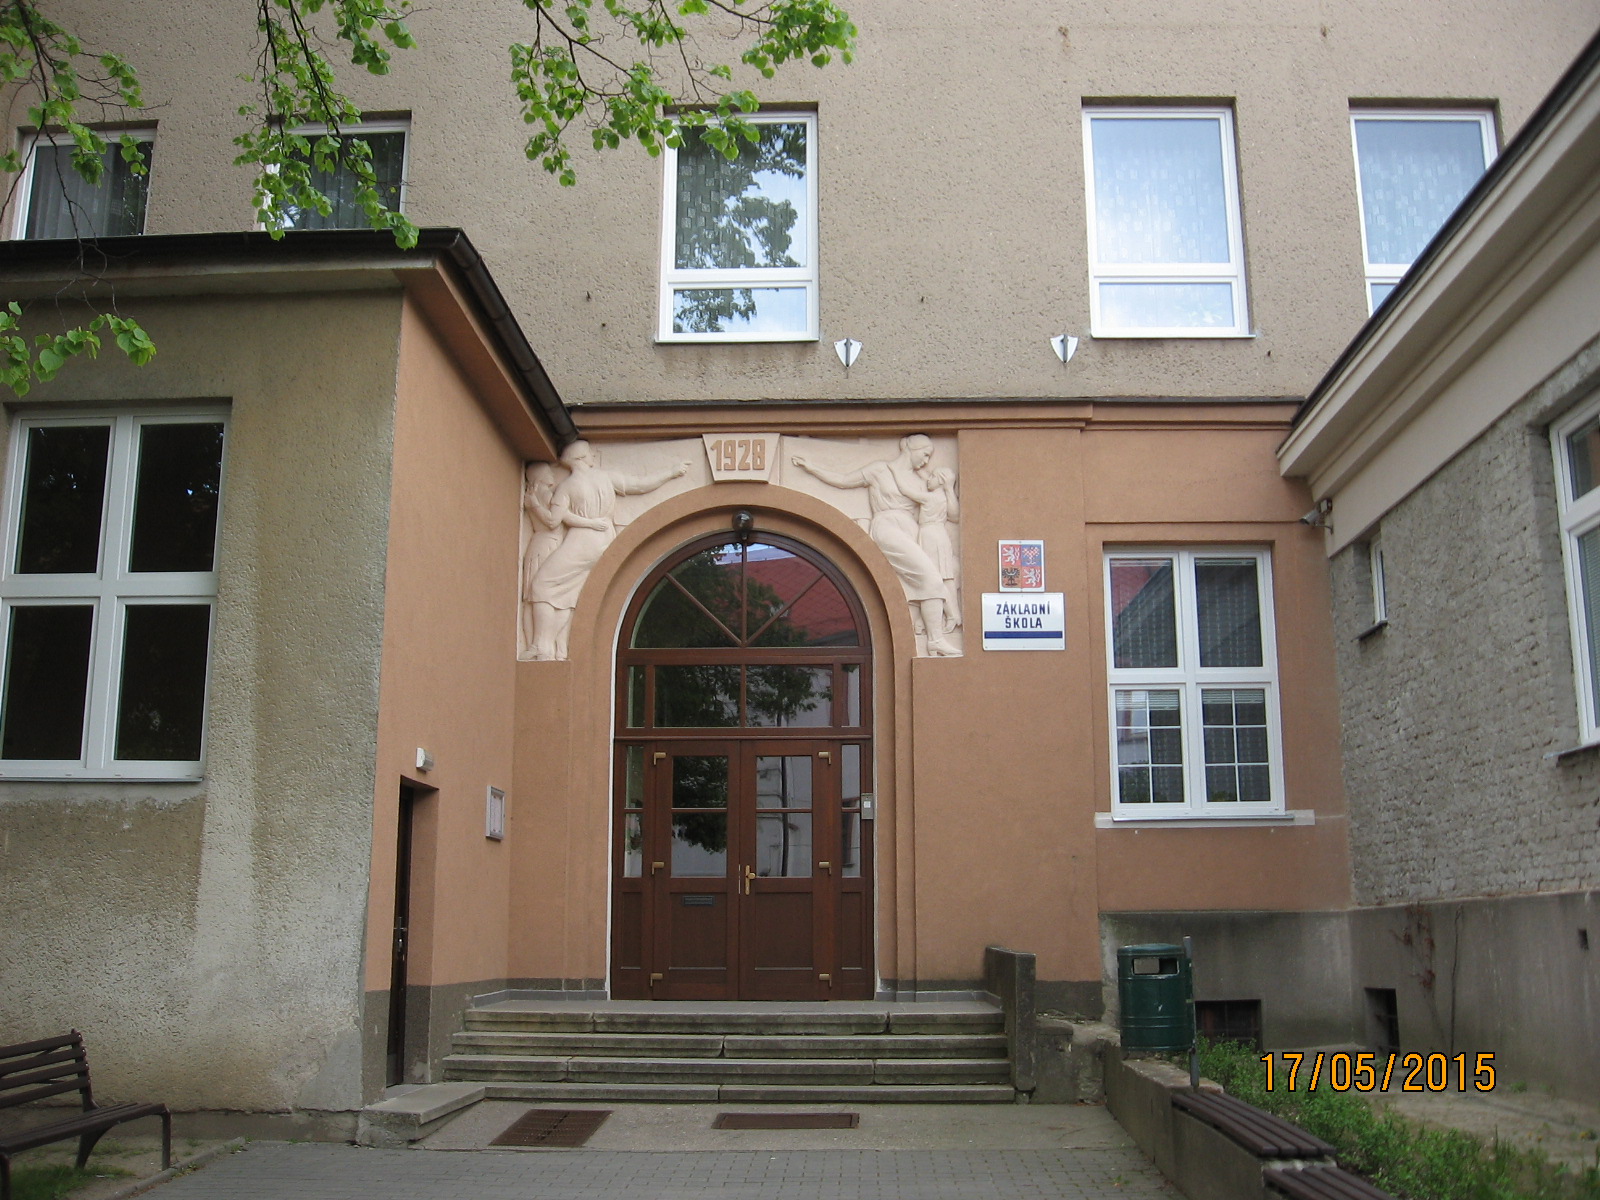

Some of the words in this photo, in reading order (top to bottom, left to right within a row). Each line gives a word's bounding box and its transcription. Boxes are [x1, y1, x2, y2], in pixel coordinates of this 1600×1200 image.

[710, 439, 766, 471] 1928
[996, 601, 1051, 615] ZÁKLADNÍ
[1005, 616, 1043, 629] ŠKOLA
